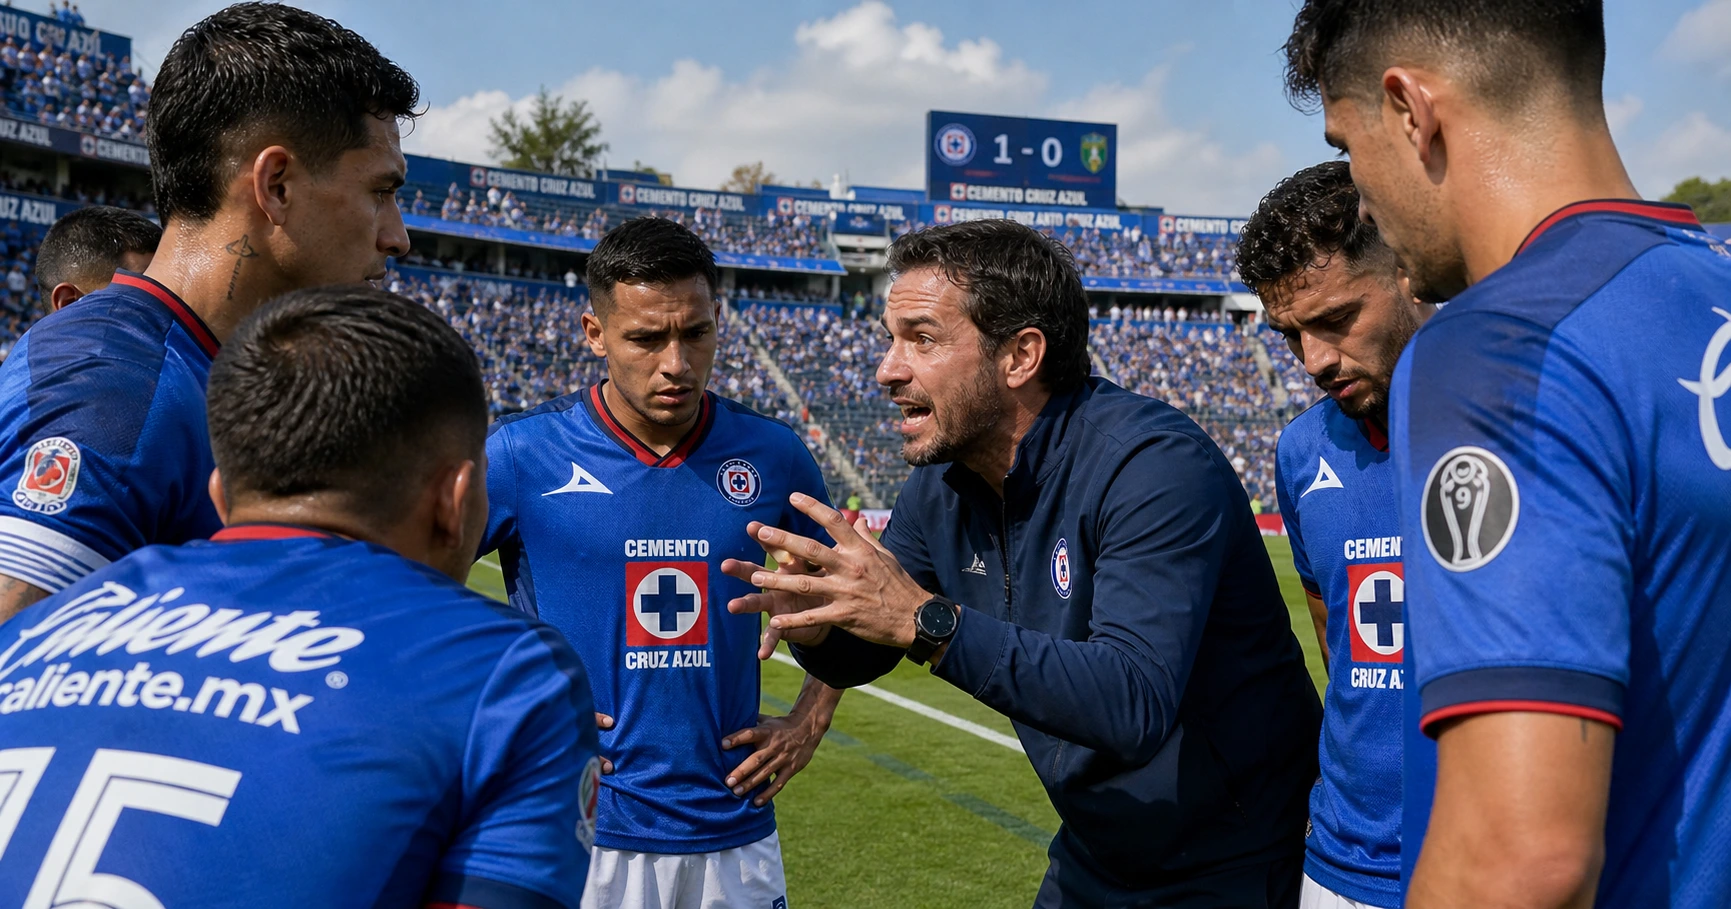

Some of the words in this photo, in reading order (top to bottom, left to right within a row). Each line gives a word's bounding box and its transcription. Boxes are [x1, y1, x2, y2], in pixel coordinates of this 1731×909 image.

[19, 123, 52, 147] AZUL
[993, 134, 1013, 165] 1
[1021, 147, 1034, 155] -
[1041, 137, 1063, 168] 0
[487, 170, 539, 192] CEMENTO
[540, 177, 568, 196] CRUZ
[569, 181, 596, 199] AZUL
[966, 185, 1024, 203] CEMENTO
[1025, 188, 1057, 205] CRUZ
[1057, 190, 1088, 206] AZUL
[636, 187, 688, 207] CEMENTO
[688, 192, 717, 209] CRUZ
[717, 195, 745, 212] AZUL
[20, 200, 58, 226] AZUL
[1094, 214, 1122, 230] AZUL
[1175, 217, 1229, 235] CEMENTO
[1455, 486, 1471, 510] 9
[625, 539, 709, 557] CEMENTO
[1344, 536, 1403, 560] CEMEN
[0, 581, 364, 681] Caliente
[625, 651, 669, 670] CRUZ
[672, 650, 711, 668] AZUL
[1351, 667, 1387, 689] CRUZ
